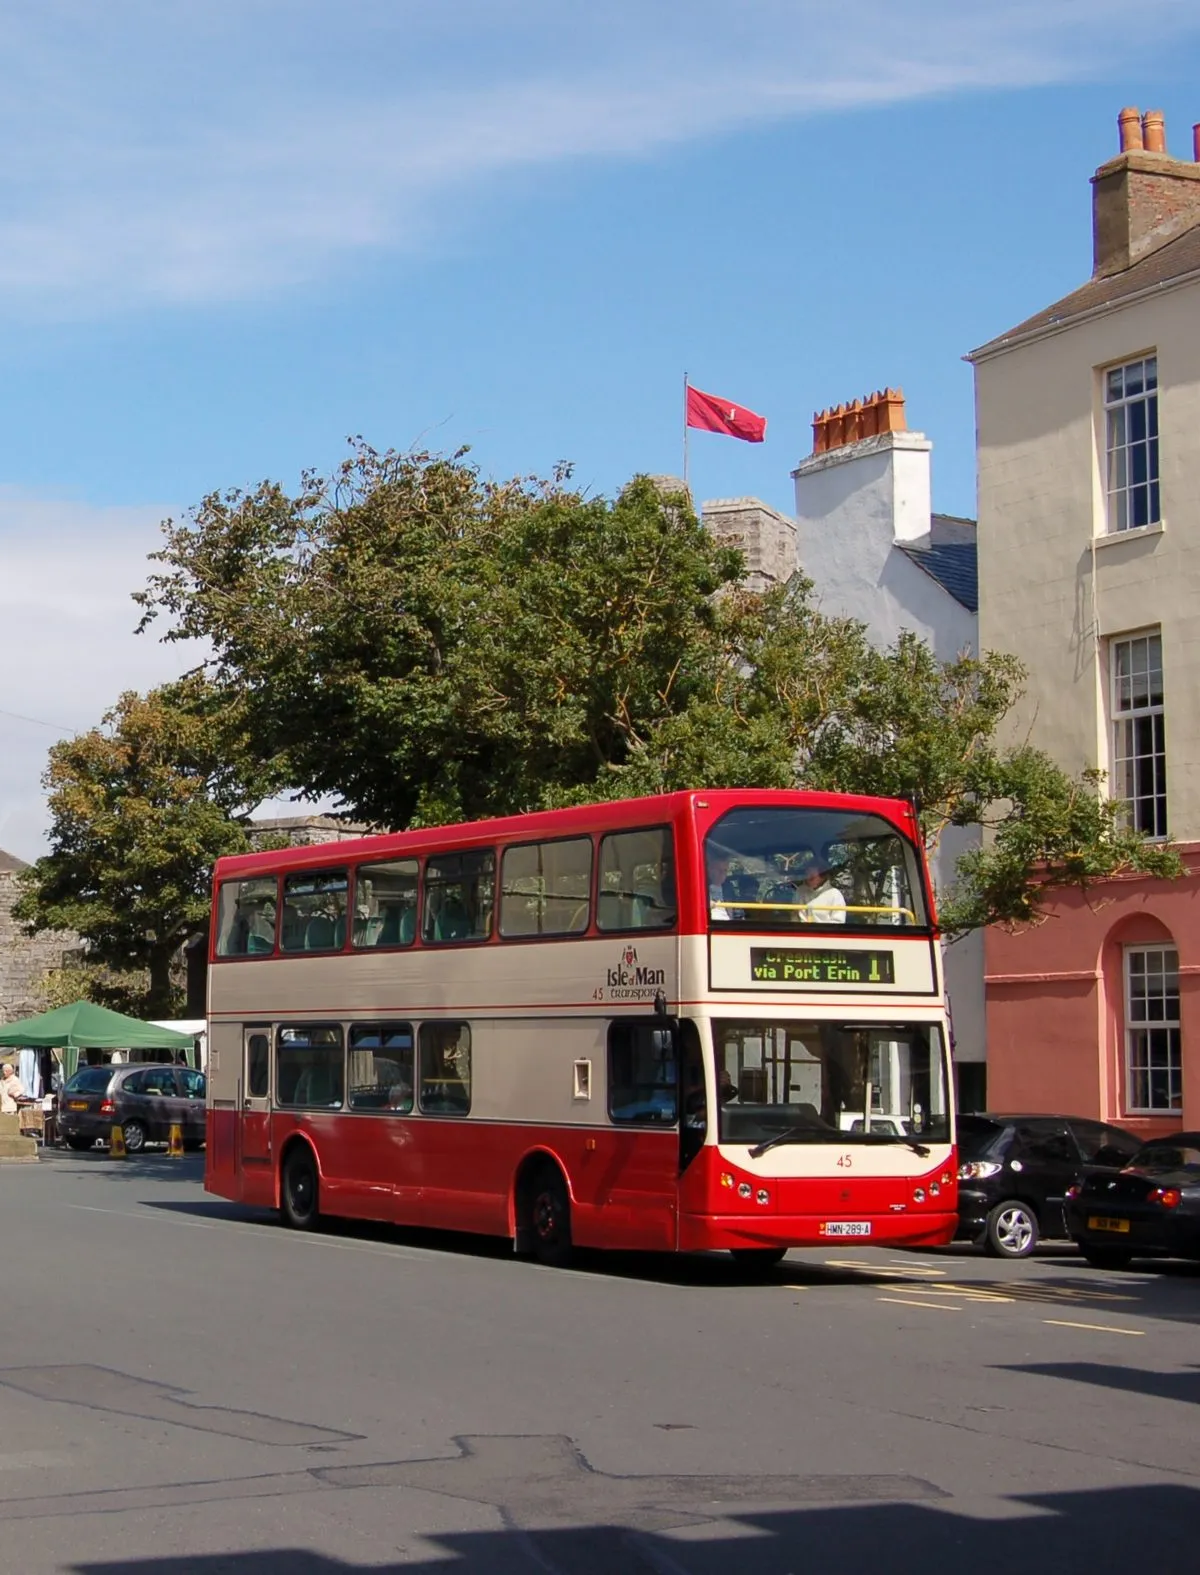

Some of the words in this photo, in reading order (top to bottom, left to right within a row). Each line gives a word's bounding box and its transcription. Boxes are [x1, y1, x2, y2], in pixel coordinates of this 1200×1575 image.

[607, 963, 629, 987] Isle
[636, 966, 665, 986] Man
[754, 964, 777, 978] via
[784, 964, 820, 980] Port
[827, 965, 860, 981] Erin
[592, 987, 604, 1001] 45
[836, 1154, 852, 1168] 45
